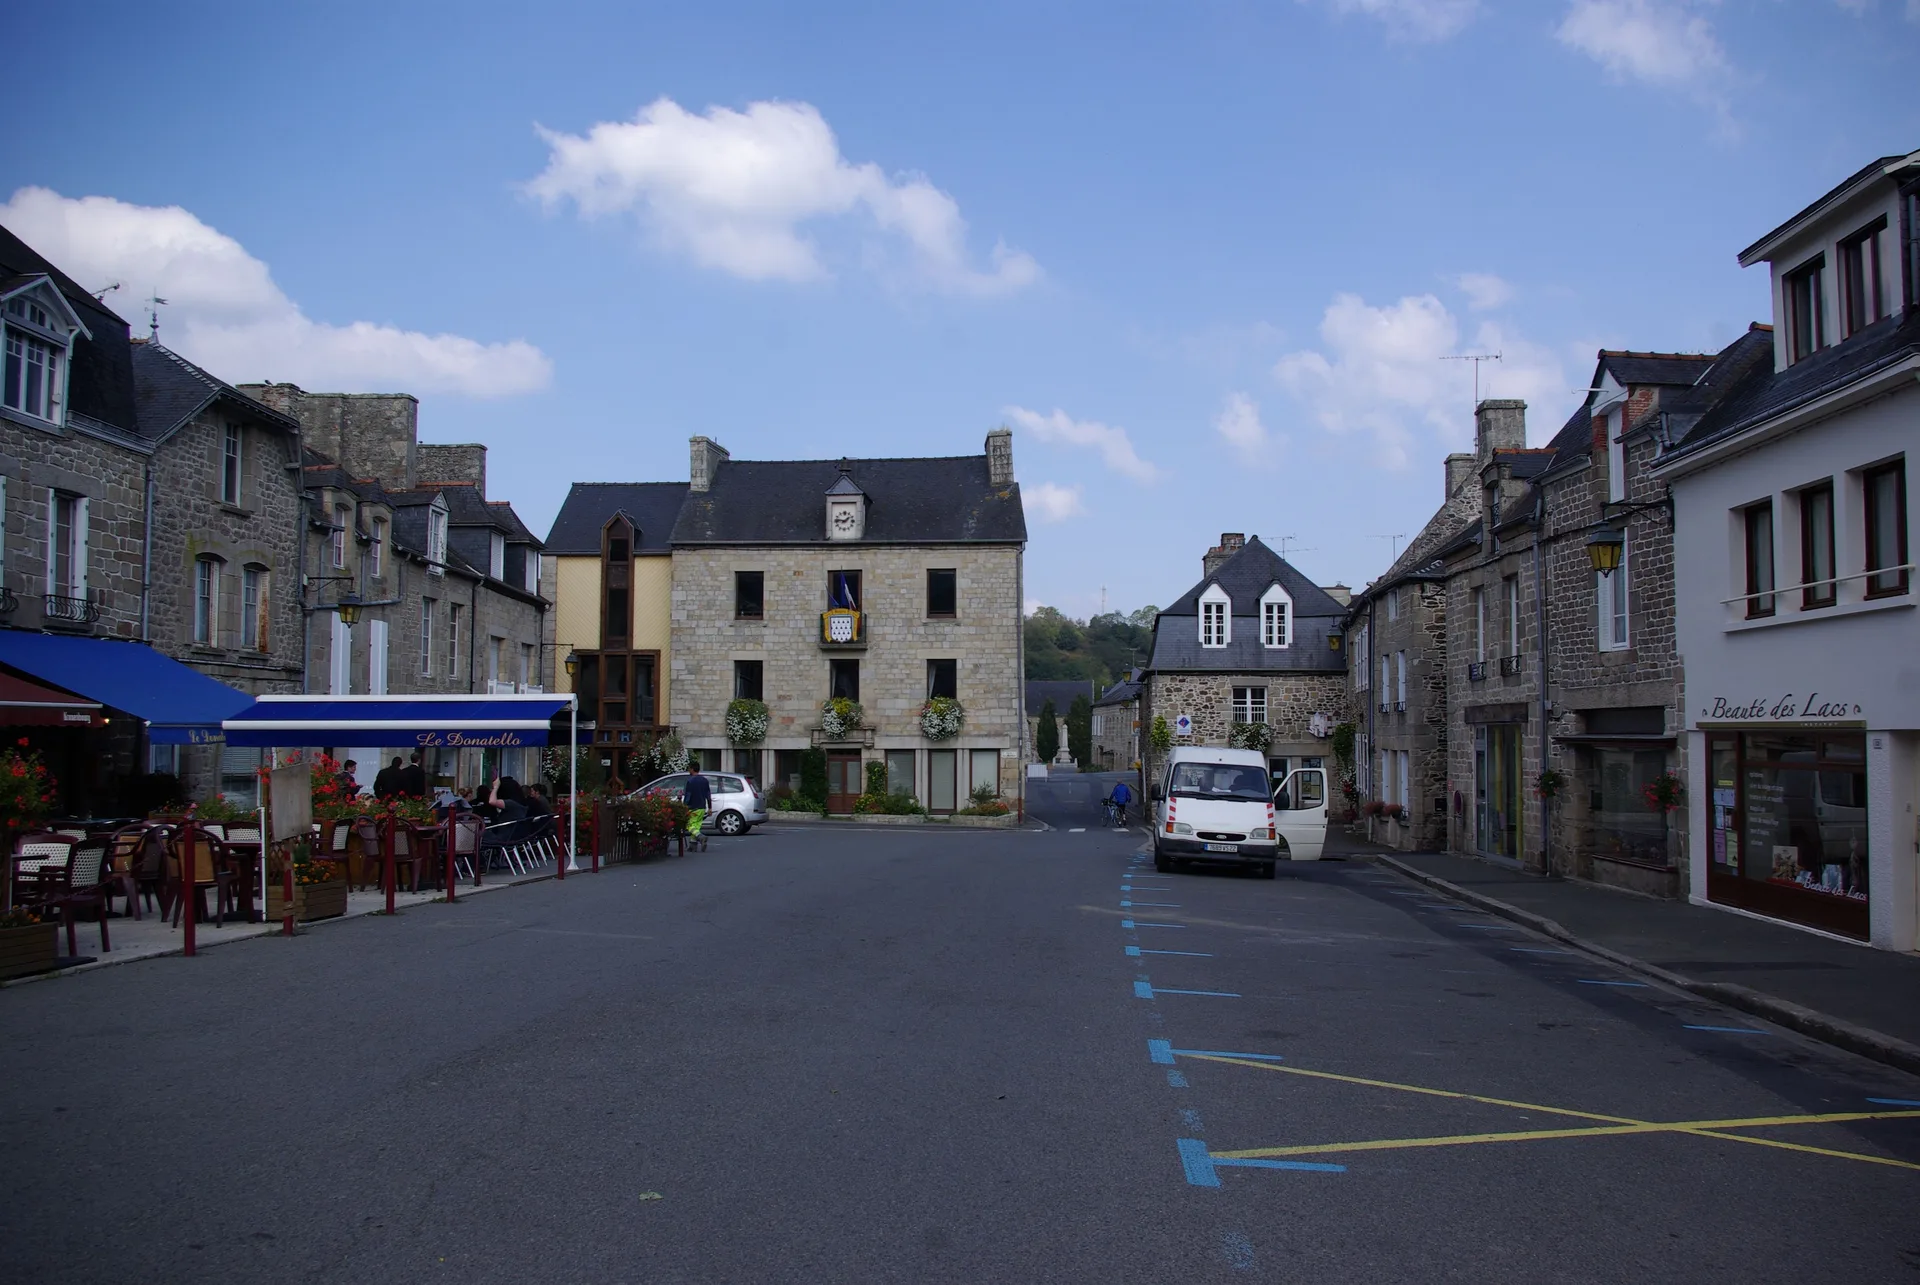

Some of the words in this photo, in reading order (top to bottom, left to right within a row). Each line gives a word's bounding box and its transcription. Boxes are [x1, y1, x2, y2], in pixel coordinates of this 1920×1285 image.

[1712, 697, 1767, 719] Beauté
[1770, 693, 1797, 719] des
[1800, 692, 1849, 718] Lacs
[416, 732, 444, 747] Le
[446, 732, 523, 747] Donatello
[1846, 885, 1868, 901] Lacs
